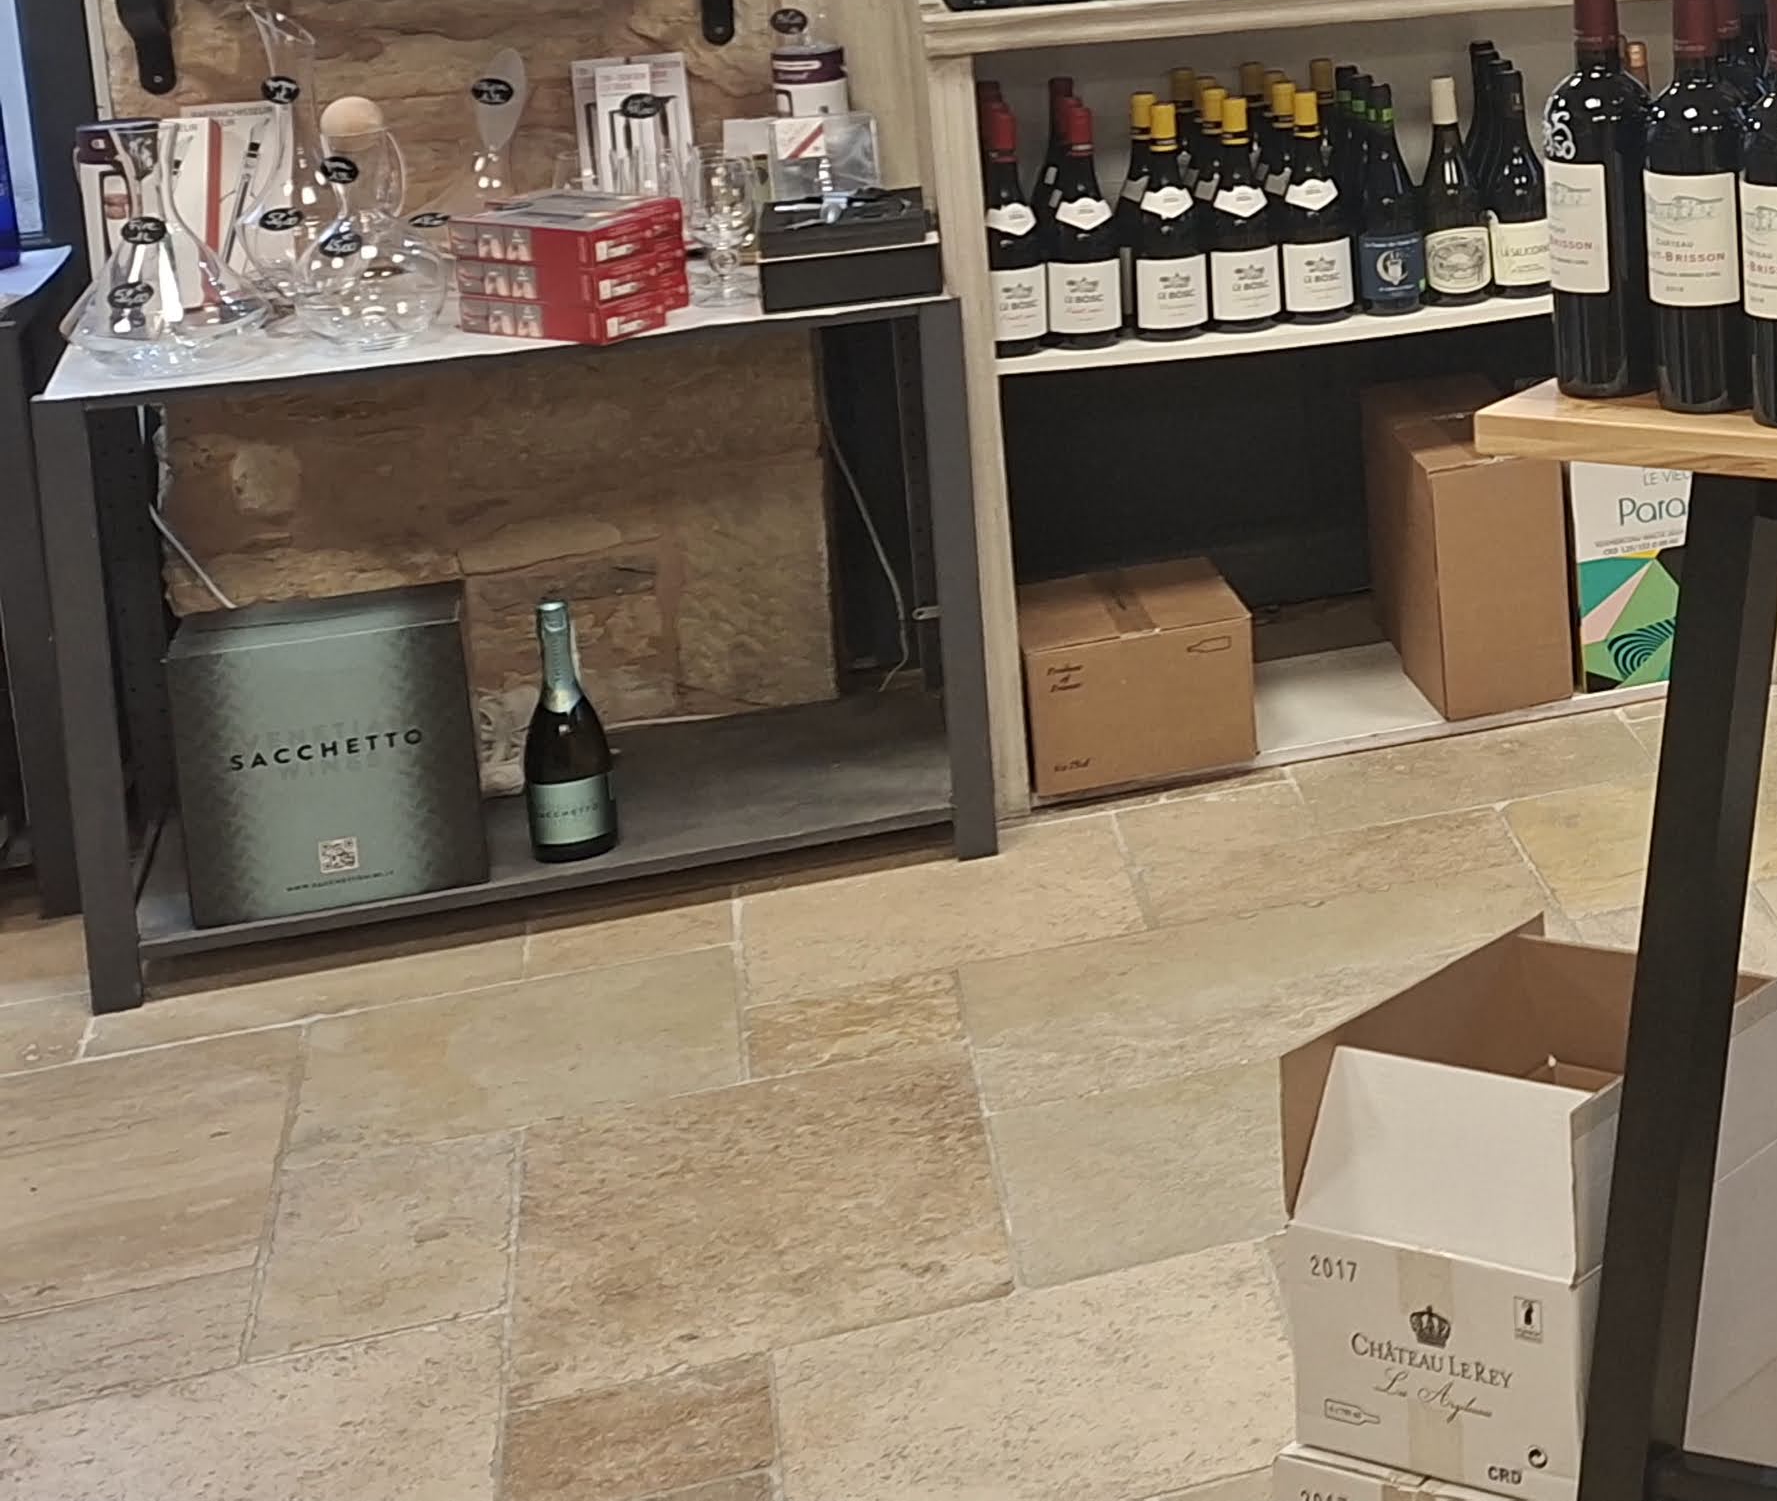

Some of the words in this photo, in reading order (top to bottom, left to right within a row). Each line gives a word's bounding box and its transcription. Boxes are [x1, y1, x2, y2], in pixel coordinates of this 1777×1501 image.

[1643, 472, 1658, 487] LE
[230, 727, 423, 772] SACCHETTO
[1308, 1253, 1358, 1283] 2017
[1350, 1331, 1445, 1374] CHÂTEAU
[1486, 1464, 1523, 1486] CRD
